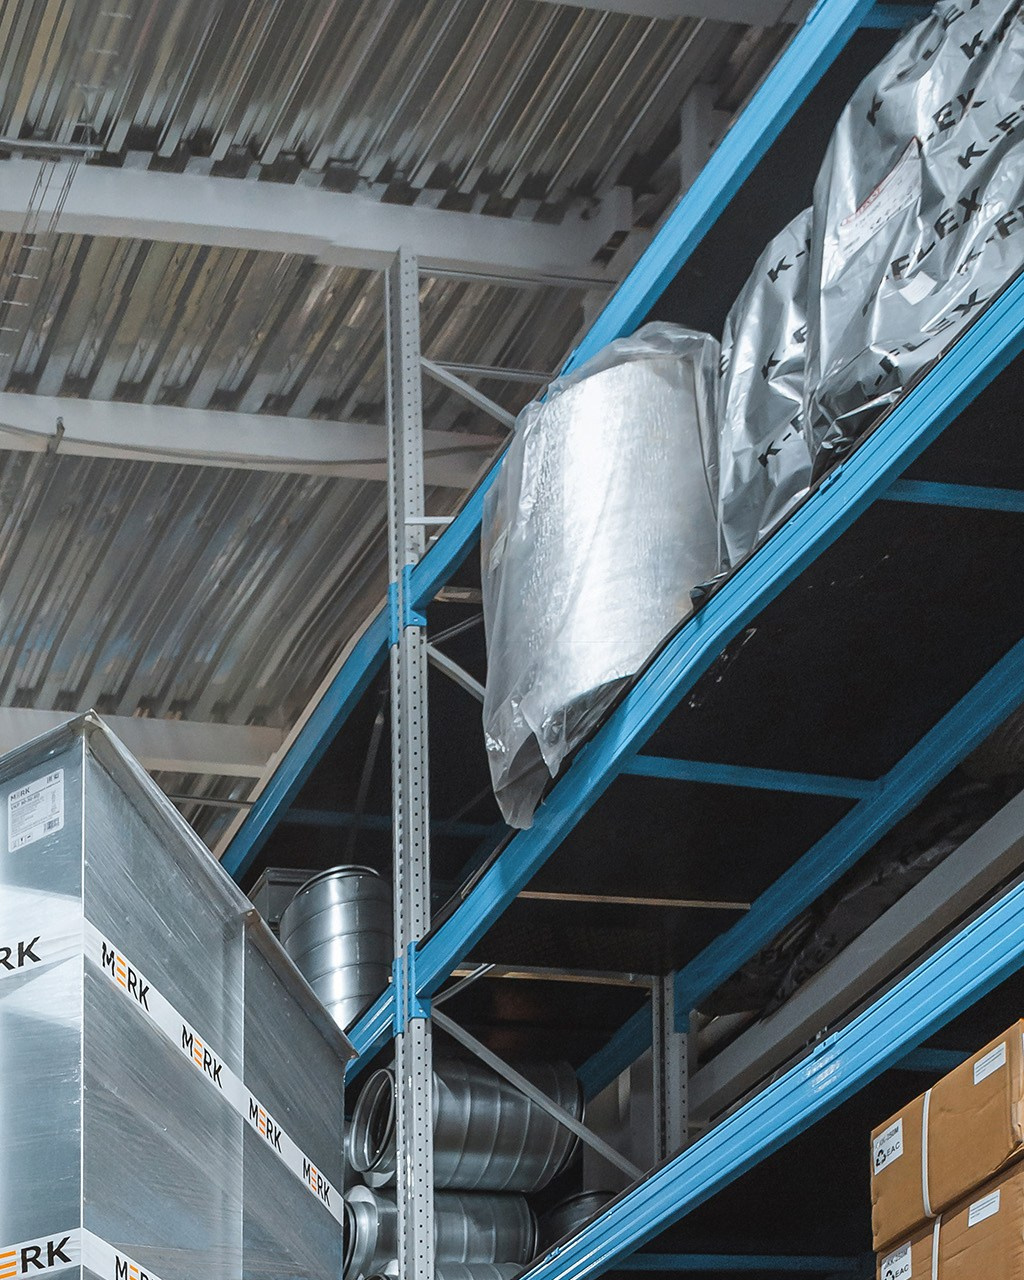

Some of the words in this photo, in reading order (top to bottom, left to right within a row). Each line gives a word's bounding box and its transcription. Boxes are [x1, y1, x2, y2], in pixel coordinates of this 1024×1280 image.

[102, 941, 150, 1011] MERK
[182, 1024, 222, 1088] MERK
[249, 1097, 282, 1153] MERK
[303, 1158, 330, 1207] MERK
[886, 1141, 901, 1157] EAC
[895, 1264, 909, 1278] EAC
